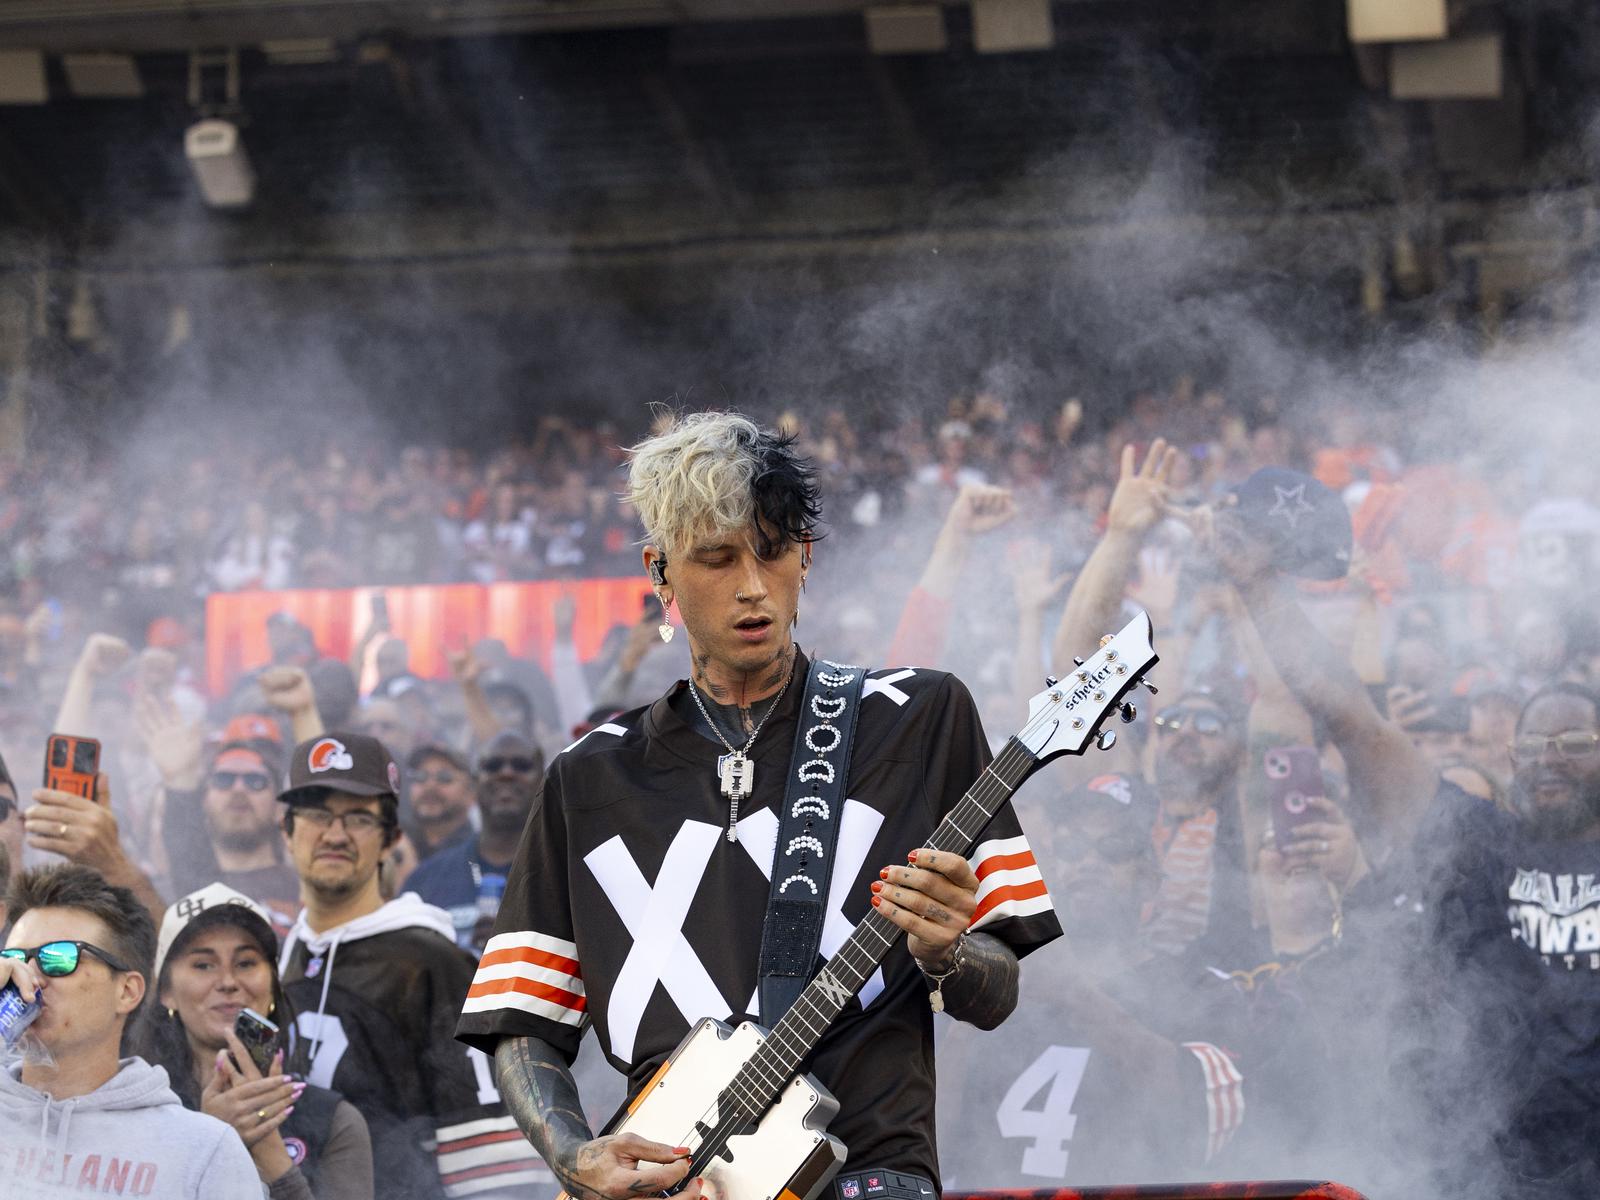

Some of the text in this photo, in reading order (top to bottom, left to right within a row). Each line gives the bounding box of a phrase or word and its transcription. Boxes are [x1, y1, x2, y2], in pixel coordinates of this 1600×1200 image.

[1065, 664, 1112, 711] schecter
[1508, 867, 1600, 917] DALL
[1, 995, 29, 1029] ULTR
[996, 1044, 1092, 1179] 4
